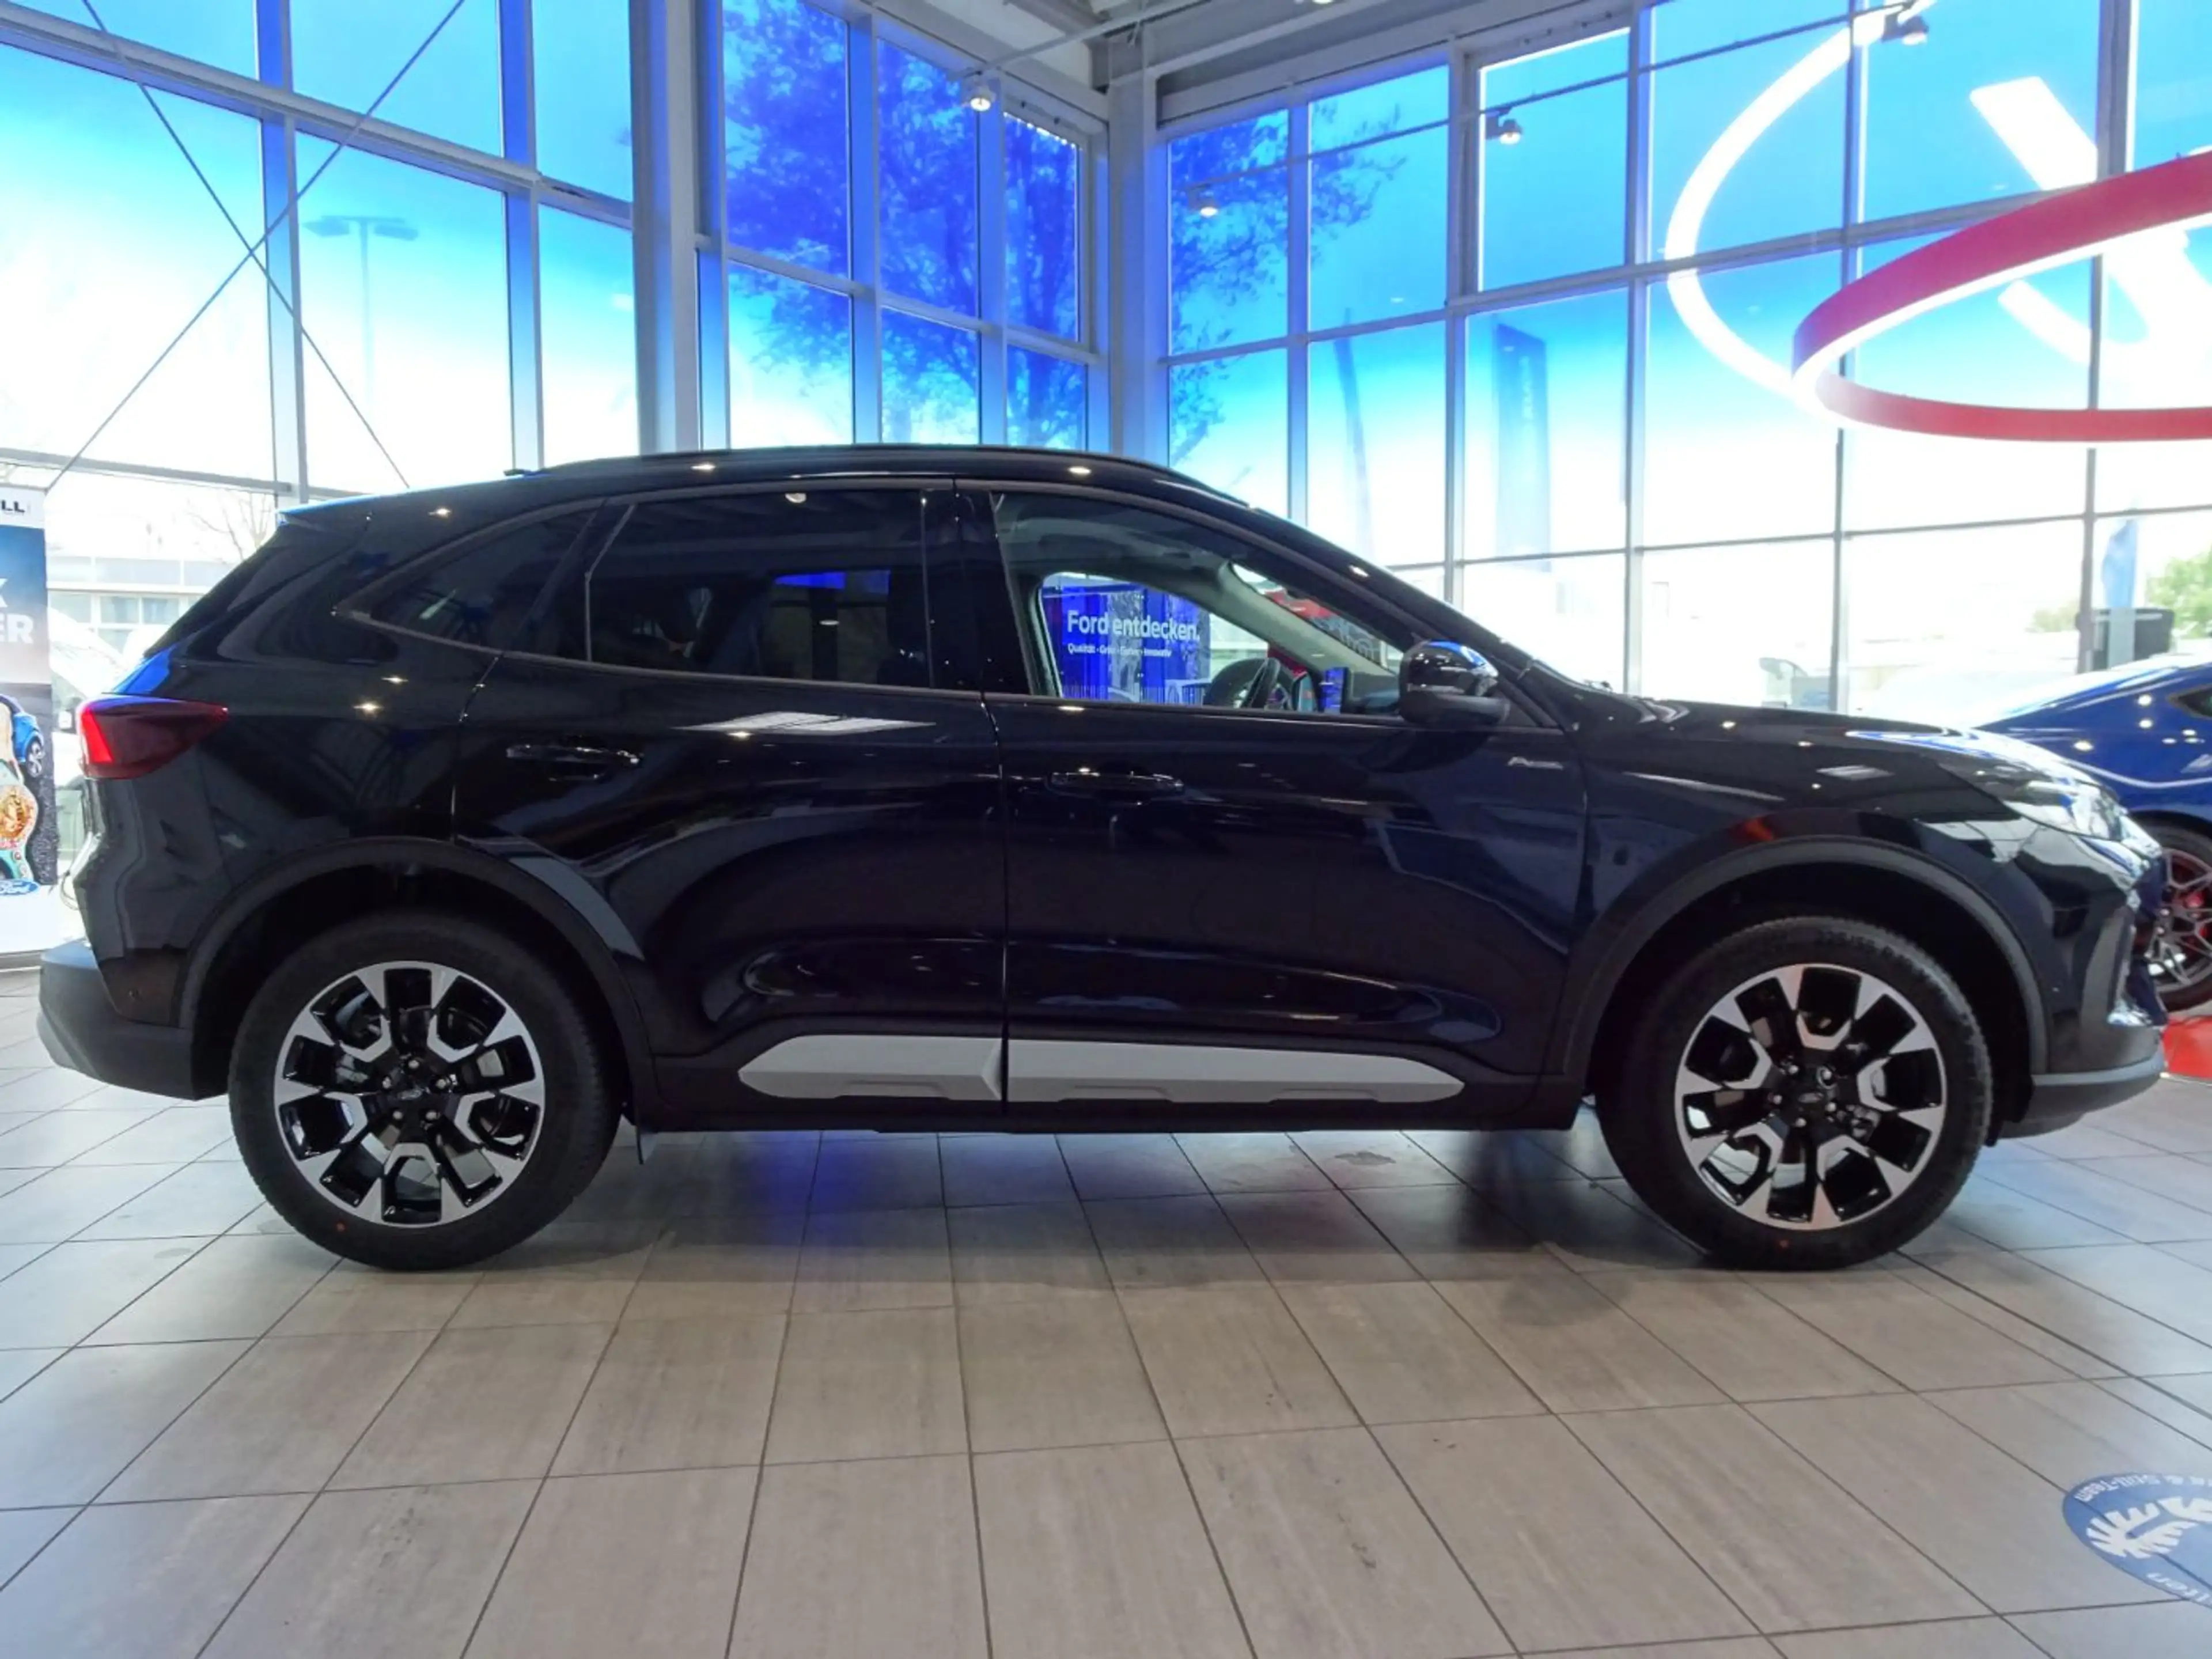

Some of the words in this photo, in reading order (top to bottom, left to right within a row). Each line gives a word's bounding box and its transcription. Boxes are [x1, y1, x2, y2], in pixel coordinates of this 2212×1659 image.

[0, 613, 33, 644] R
[1067, 609, 1109, 635] Ford
[1112, 615, 1200, 641] entdecken.
